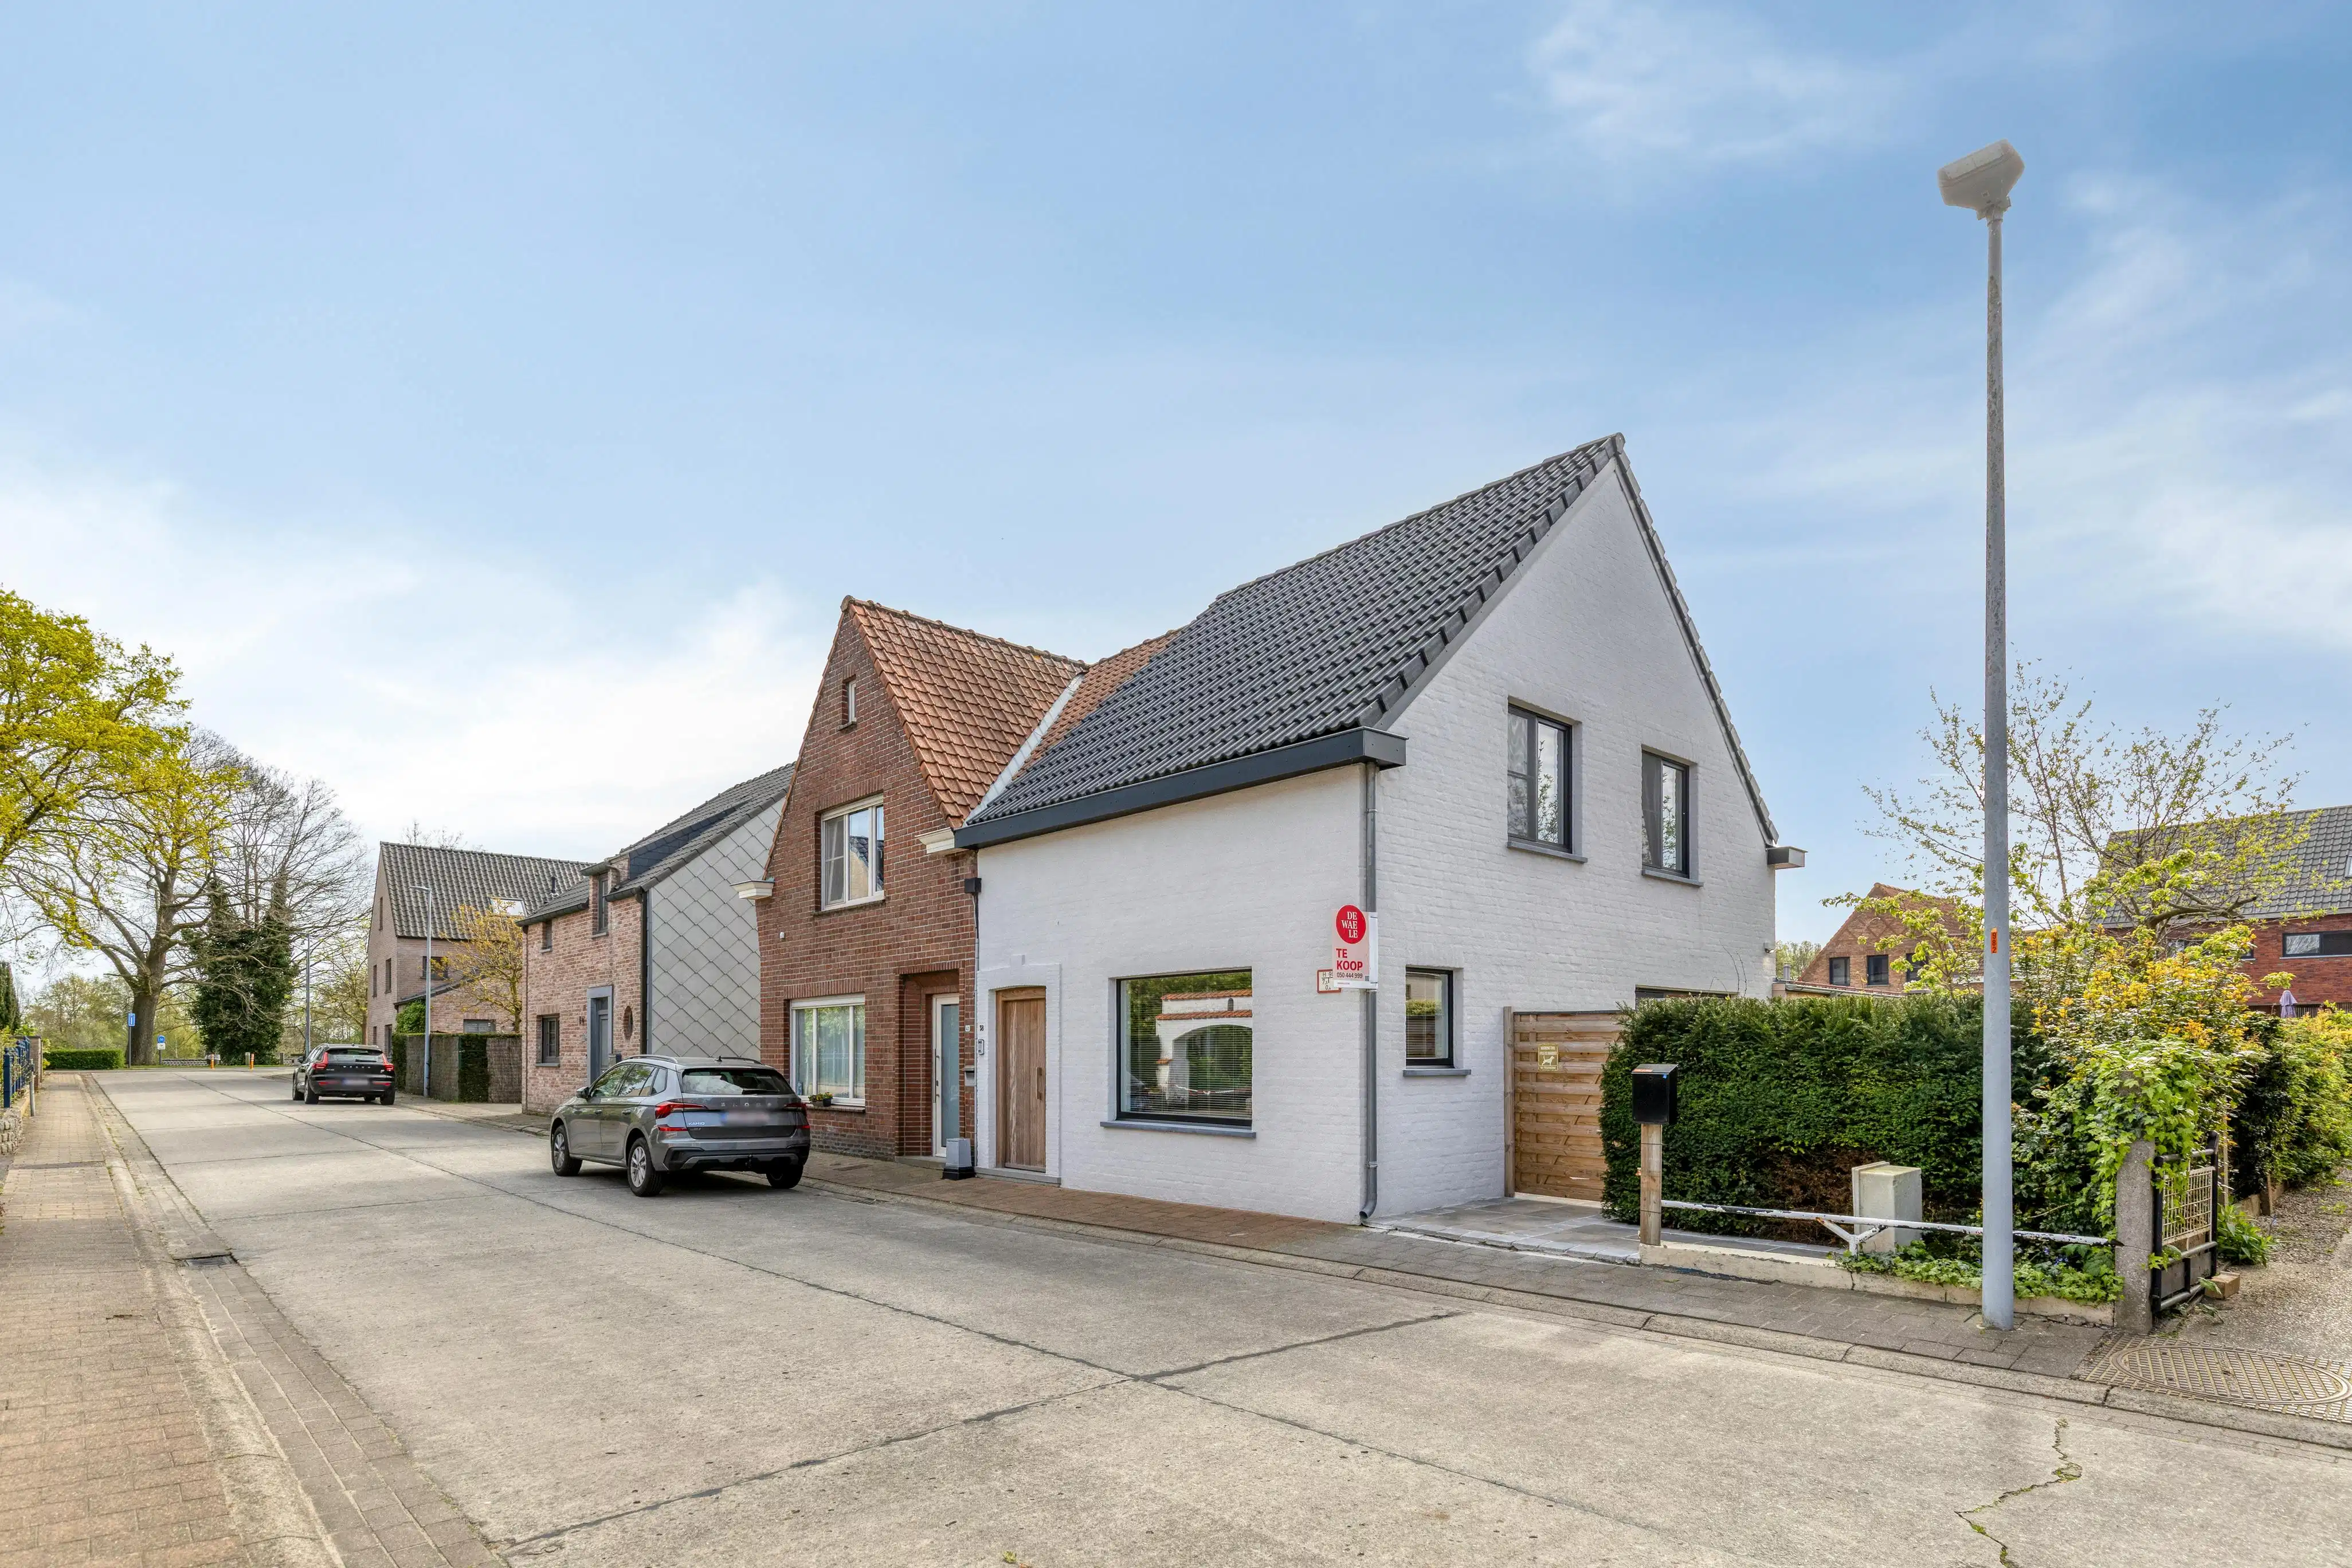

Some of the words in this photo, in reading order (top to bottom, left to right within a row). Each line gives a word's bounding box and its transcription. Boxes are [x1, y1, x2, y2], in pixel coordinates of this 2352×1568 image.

[1347, 911, 1358, 920] DE
[1341, 920, 1358, 929] WAE
[1349, 929, 1358, 938] LE
[1336, 948, 1348, 958] TE
[1336, 960, 1363, 971] KOOP
